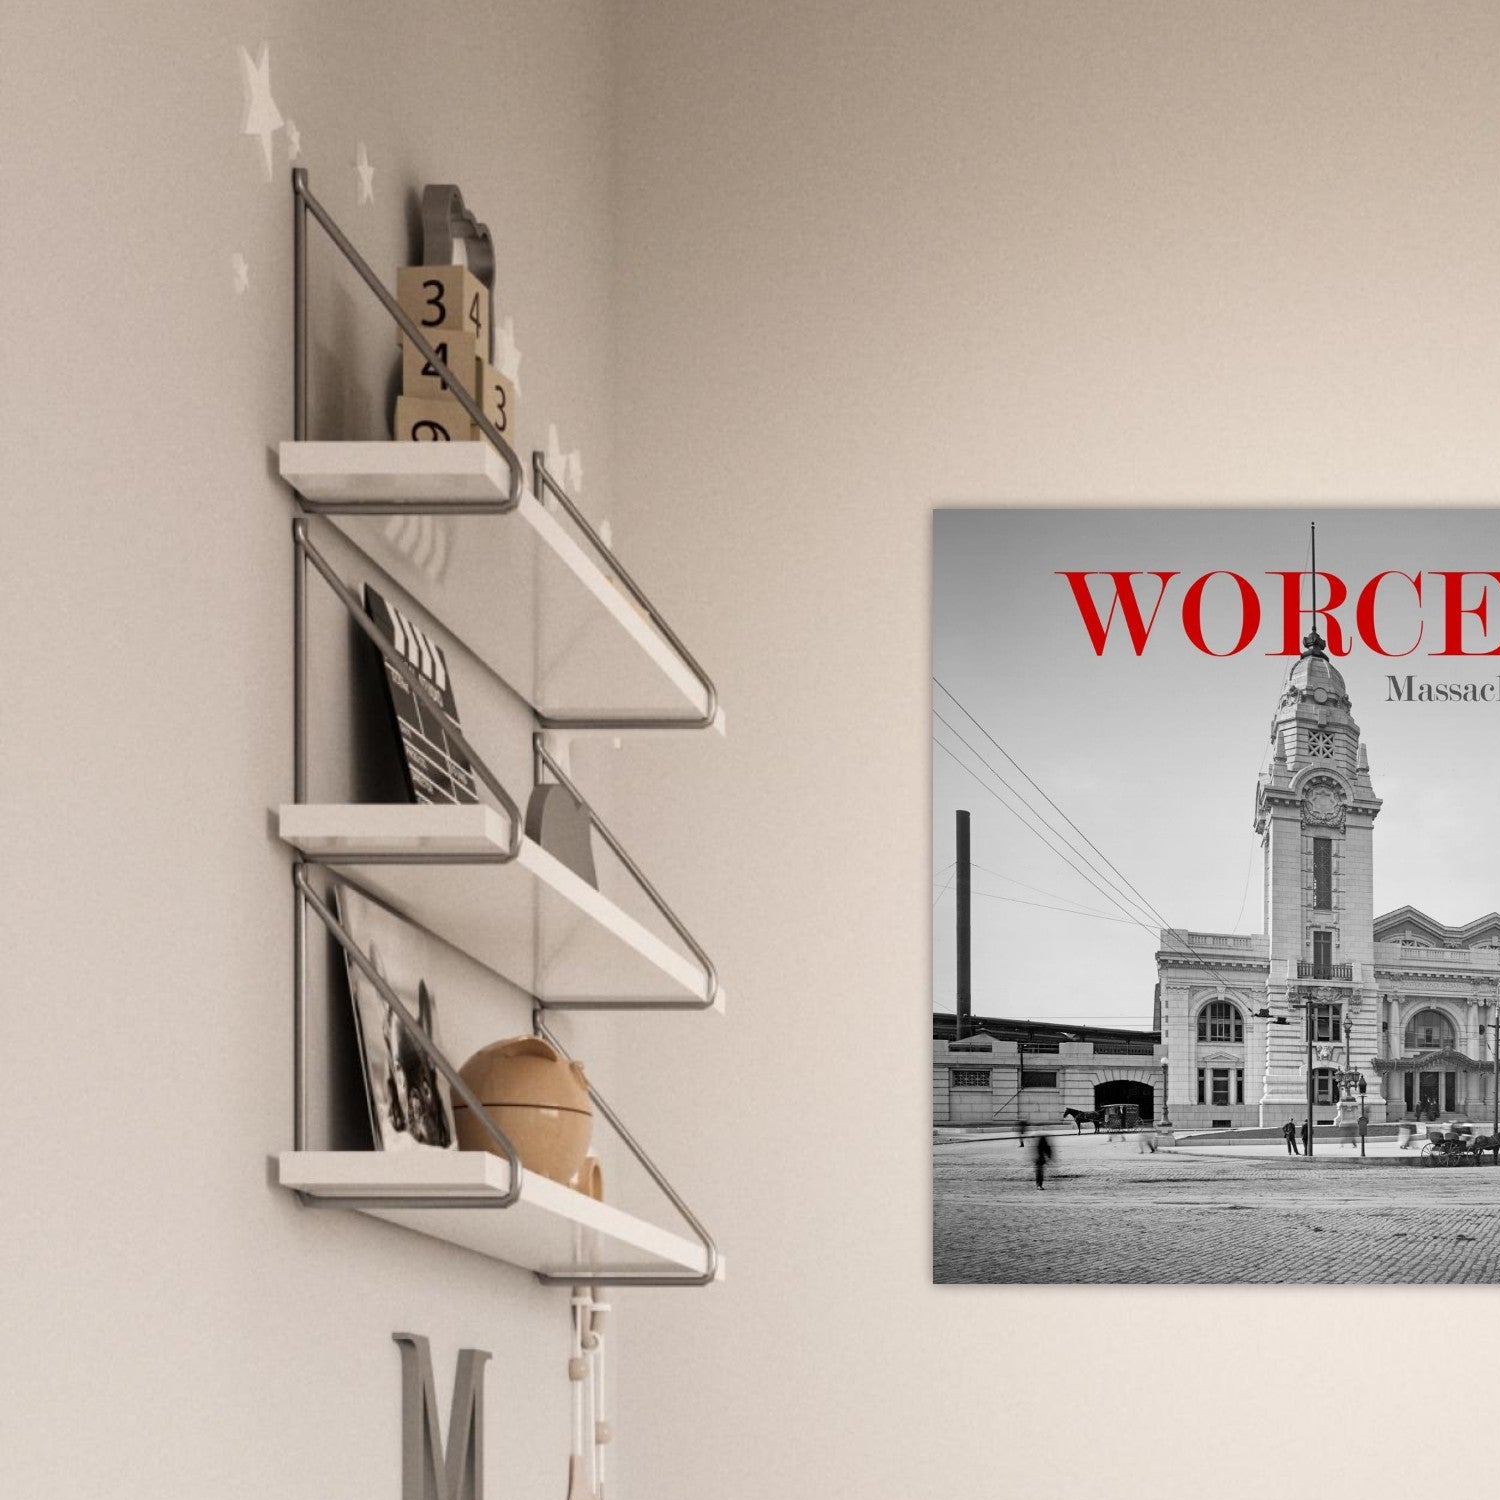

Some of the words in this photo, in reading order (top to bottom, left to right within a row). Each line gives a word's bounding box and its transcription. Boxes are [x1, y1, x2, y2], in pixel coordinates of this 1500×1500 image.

[421, 279, 446, 327] 3
[469, 291, 482, 338] 4
[421, 342, 450, 390] 4
[495, 385, 507, 432] 3
